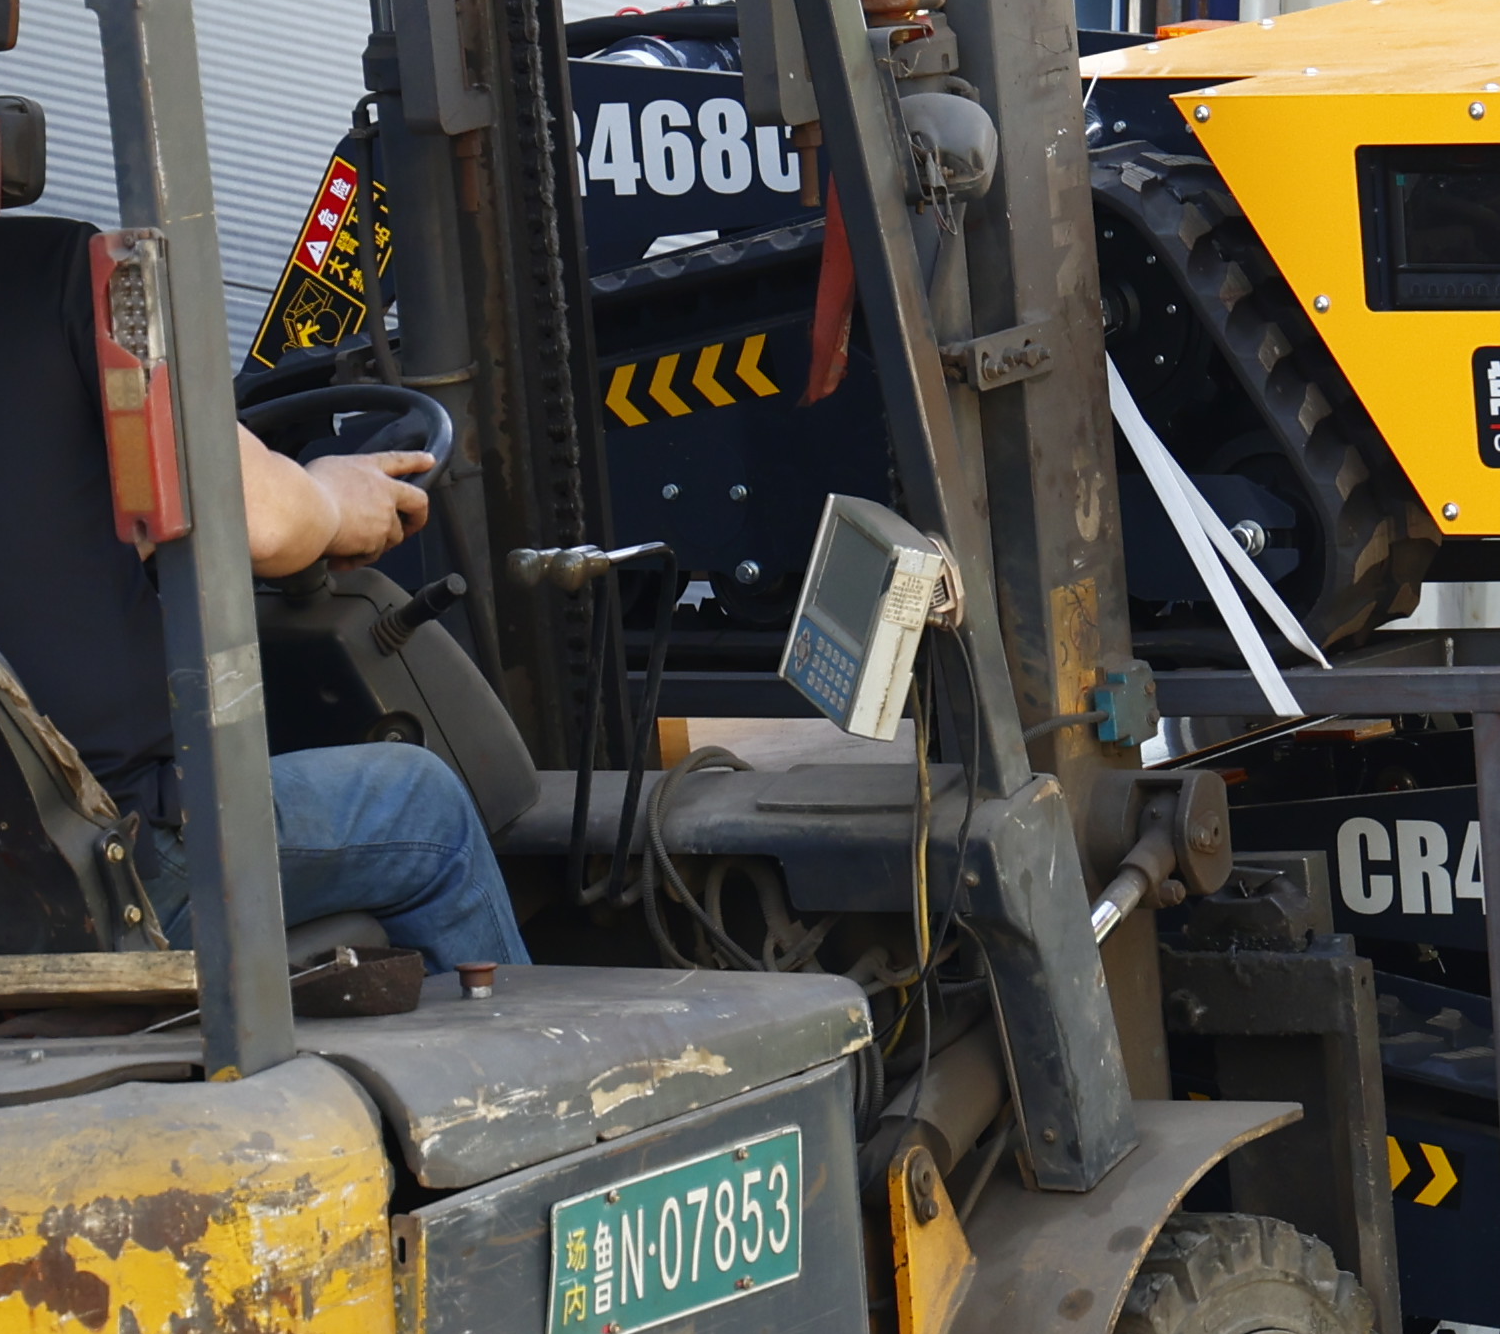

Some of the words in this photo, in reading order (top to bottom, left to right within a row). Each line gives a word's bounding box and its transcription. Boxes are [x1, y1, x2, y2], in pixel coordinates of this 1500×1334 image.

[572, 97, 801, 197] 468C
[316, 176, 353, 232] 危险
[561, 1227, 588, 1327] 场内
